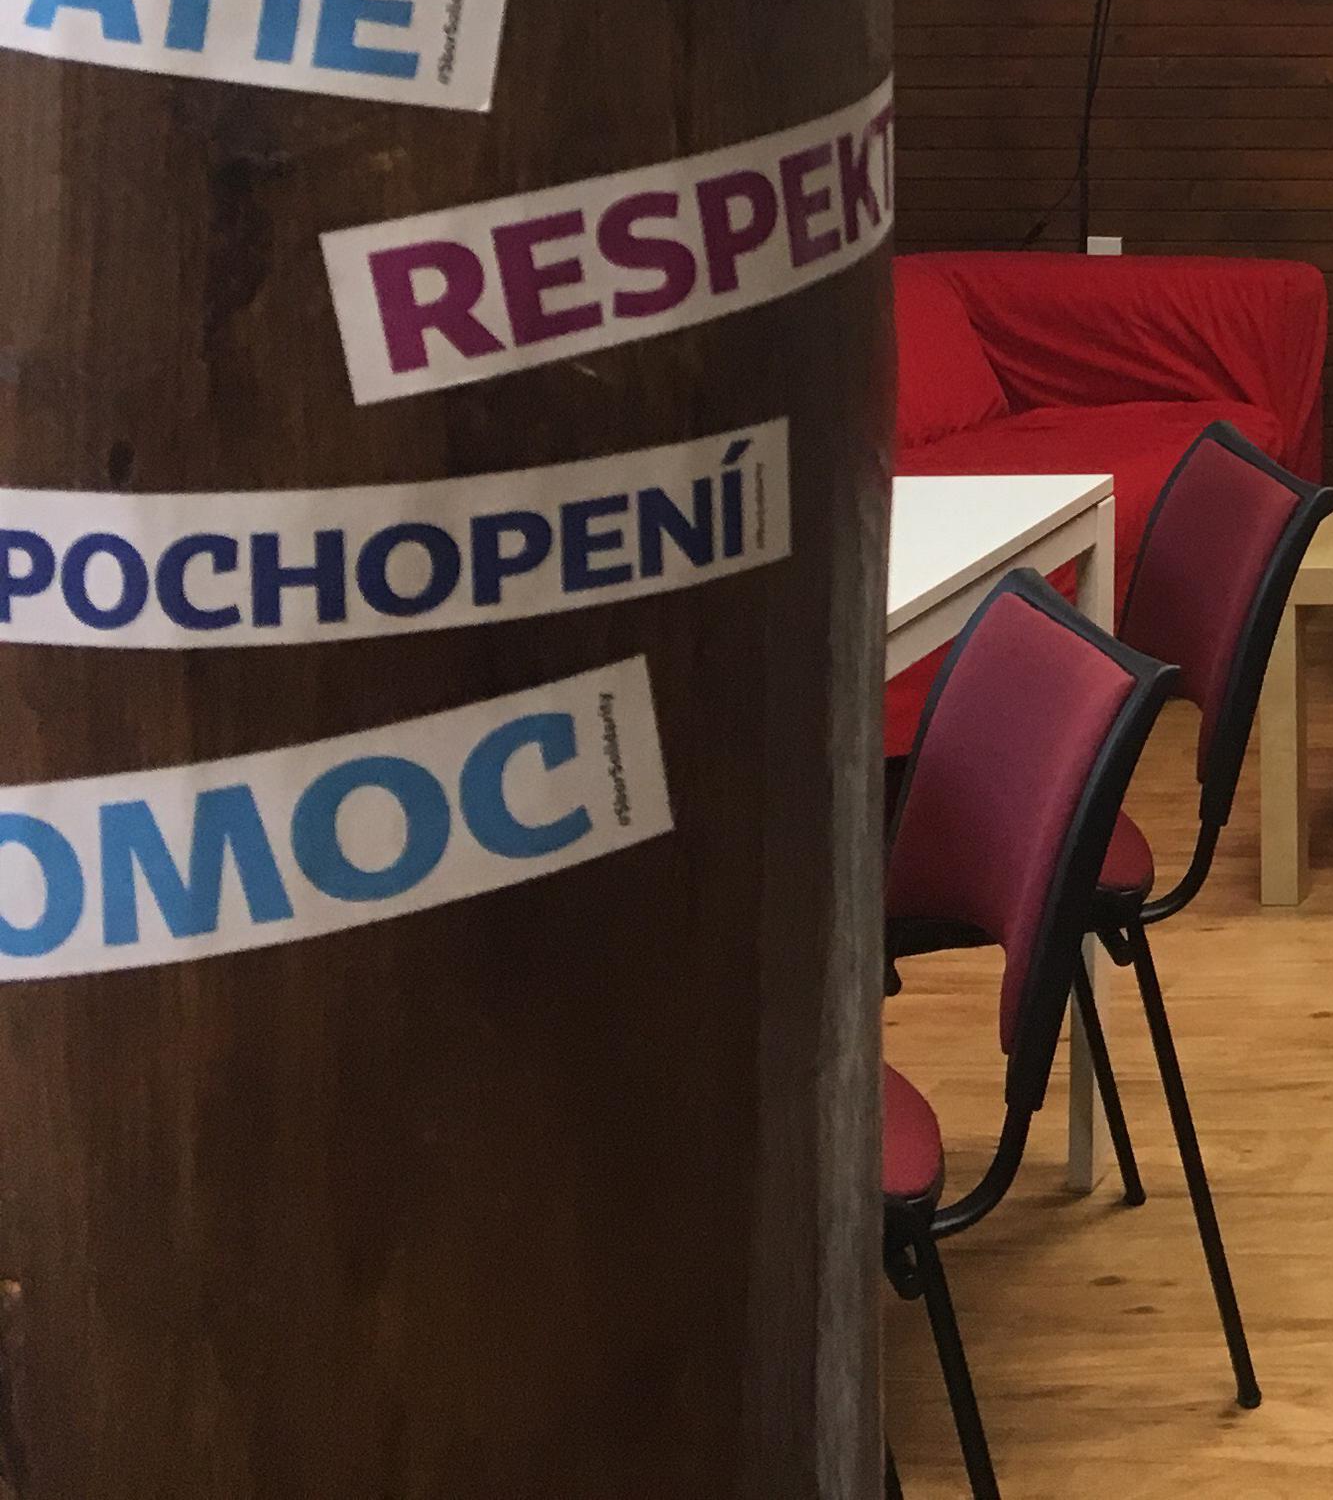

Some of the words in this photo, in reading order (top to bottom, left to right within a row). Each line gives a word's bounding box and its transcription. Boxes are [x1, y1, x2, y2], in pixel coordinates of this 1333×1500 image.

[368, 101, 895, 375] RESPEKT
[0, 438, 753, 631] POCHOPENÍ
[0, 711, 594, 958] OMOC
